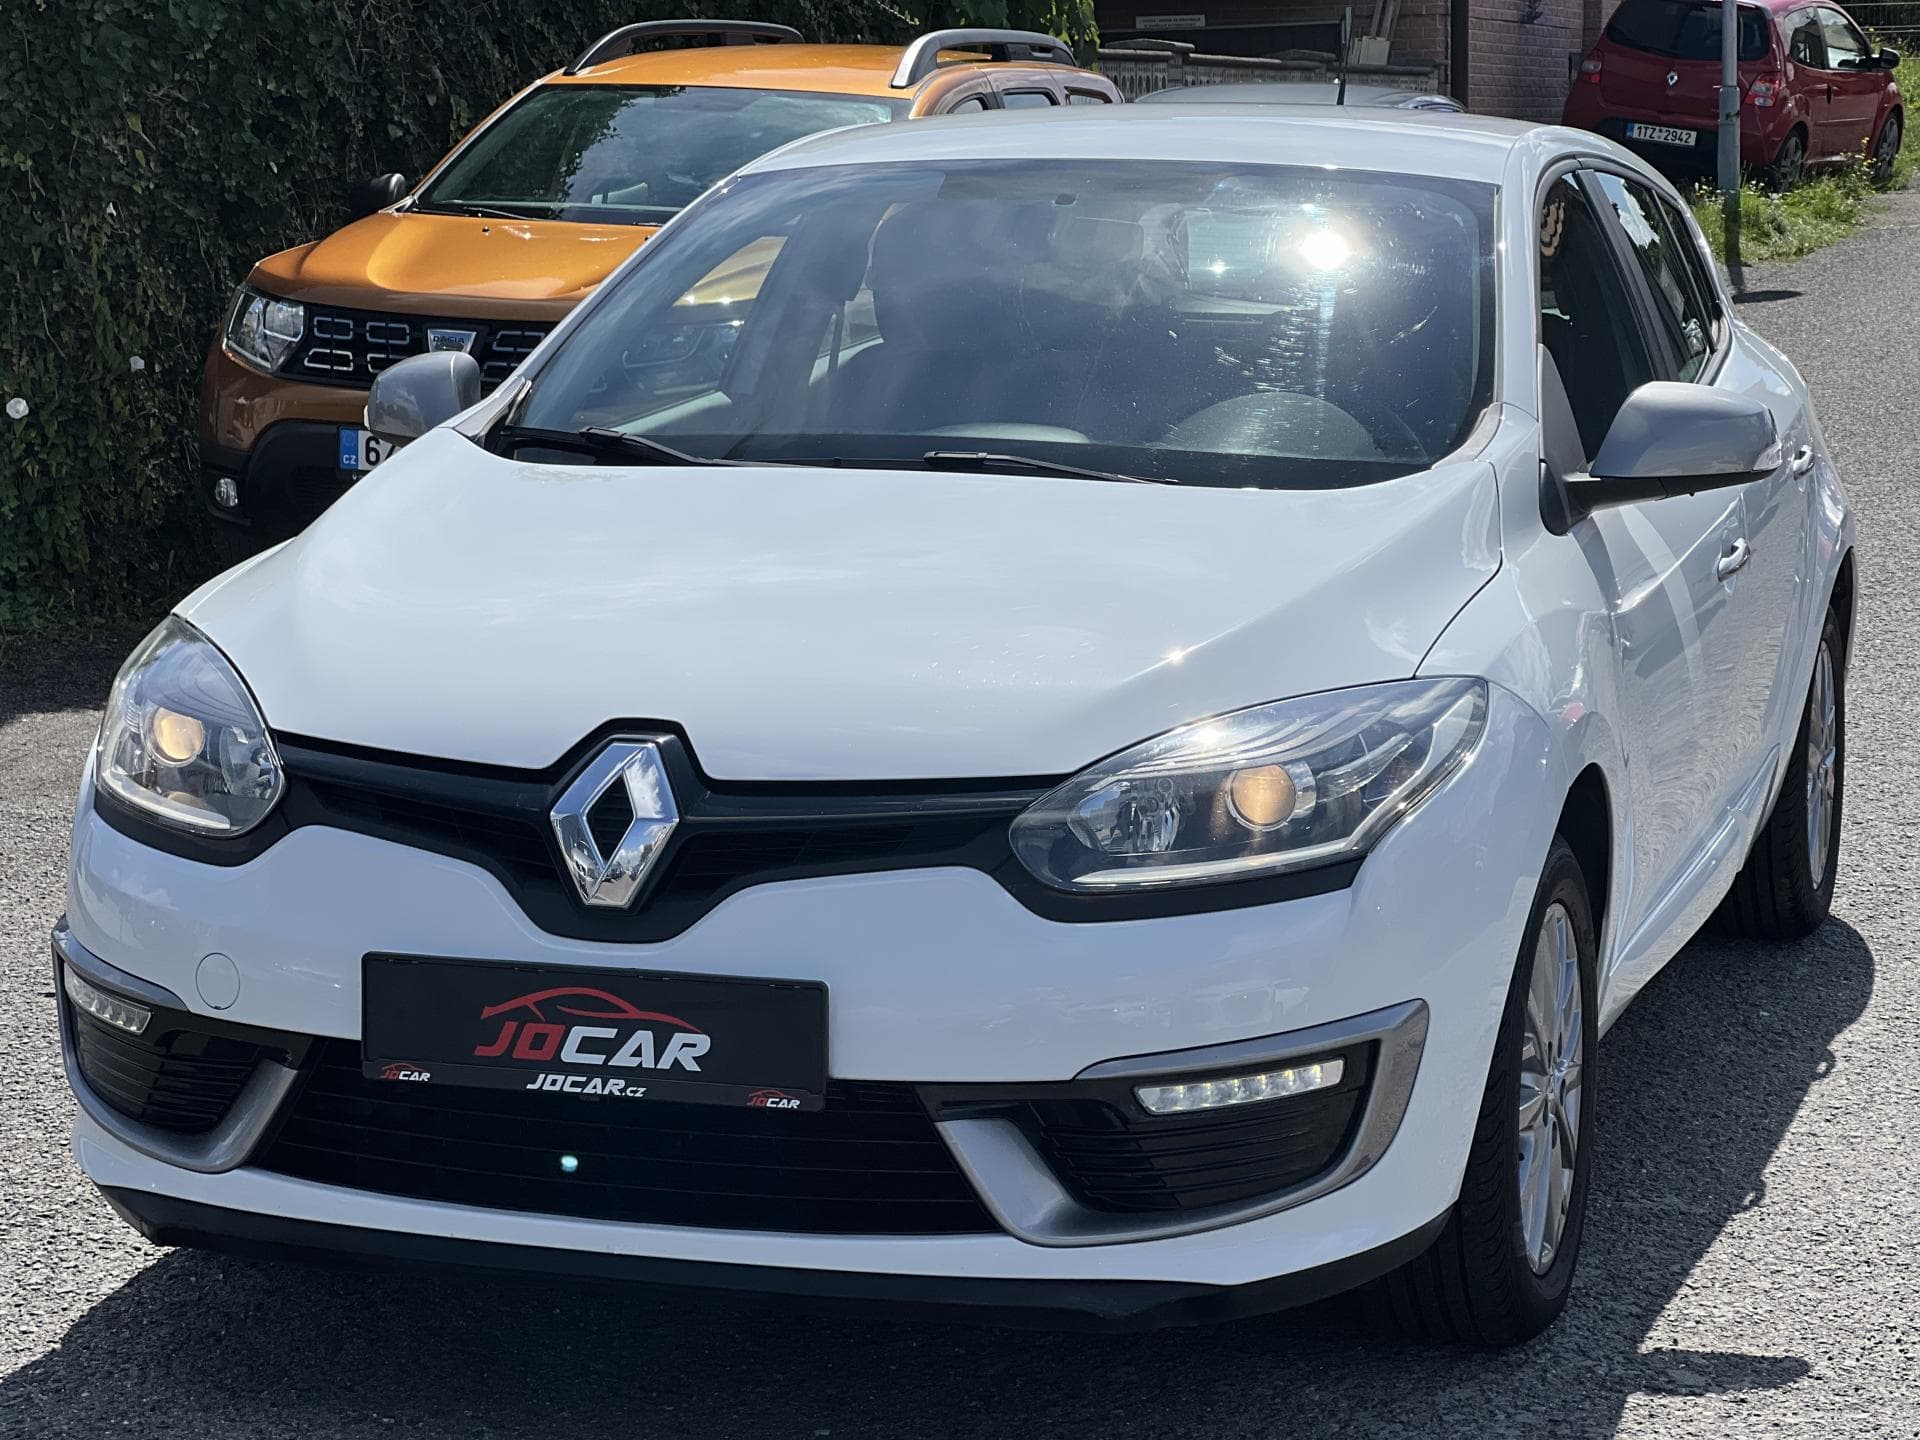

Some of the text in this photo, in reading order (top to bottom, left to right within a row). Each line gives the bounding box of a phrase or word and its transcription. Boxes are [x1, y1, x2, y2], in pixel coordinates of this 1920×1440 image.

[1637, 126, 1692, 144] 1TZ 2942
[343, 454, 357, 465] CZ
[474, 1019, 711, 1072] JOCAR
[380, 1070, 431, 1082] JOCAR
[747, 1096, 801, 1109] JOCAR
